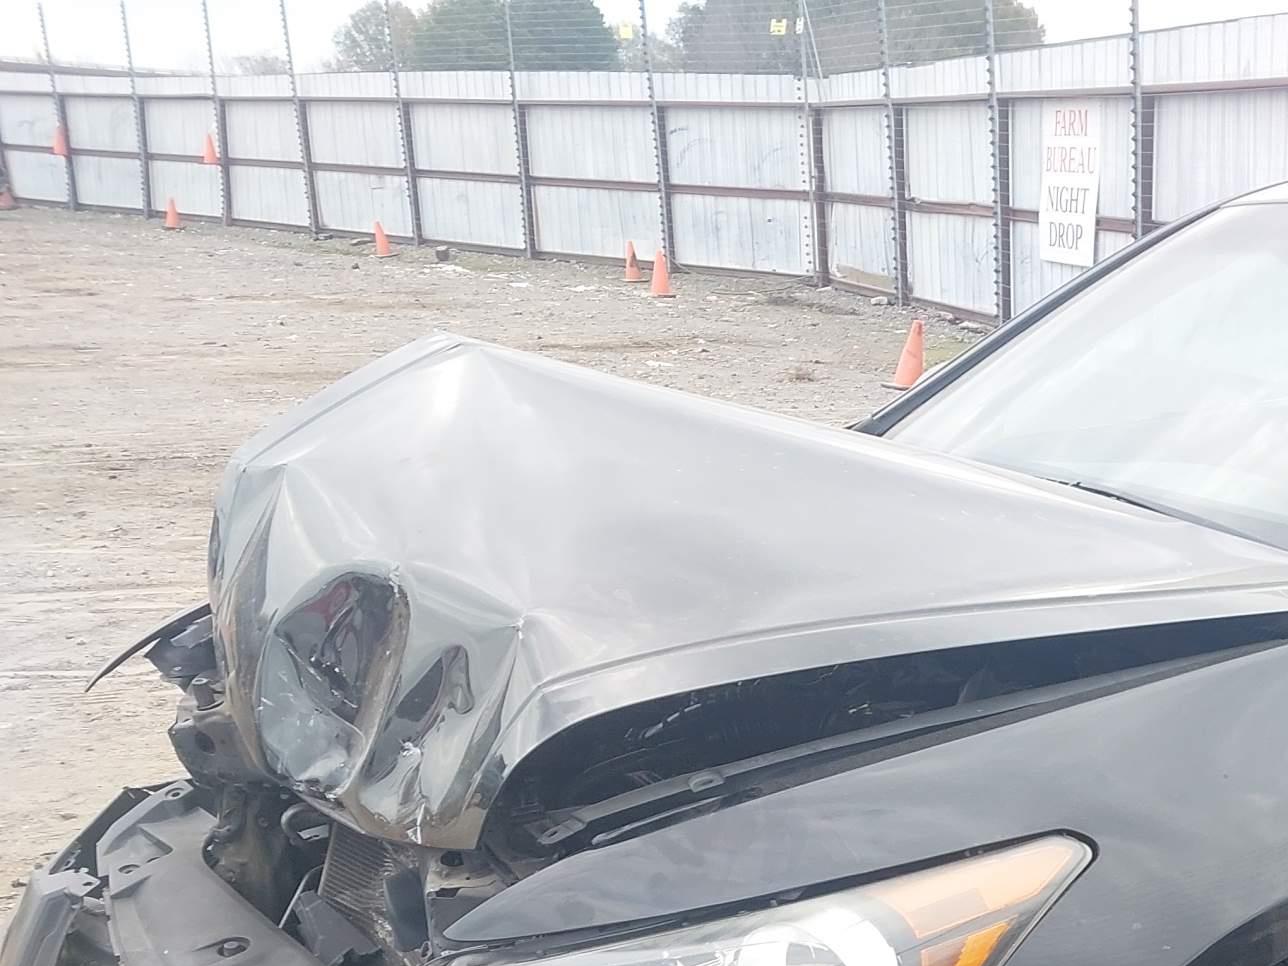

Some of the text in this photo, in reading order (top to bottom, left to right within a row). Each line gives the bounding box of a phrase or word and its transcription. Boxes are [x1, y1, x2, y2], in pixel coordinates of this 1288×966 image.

[1054, 109, 1088, 137] FARM
[1046, 146, 1096, 174] BUREAU
[1047, 185, 1090, 214] NIGHT
[1049, 221, 1083, 250] DROP
